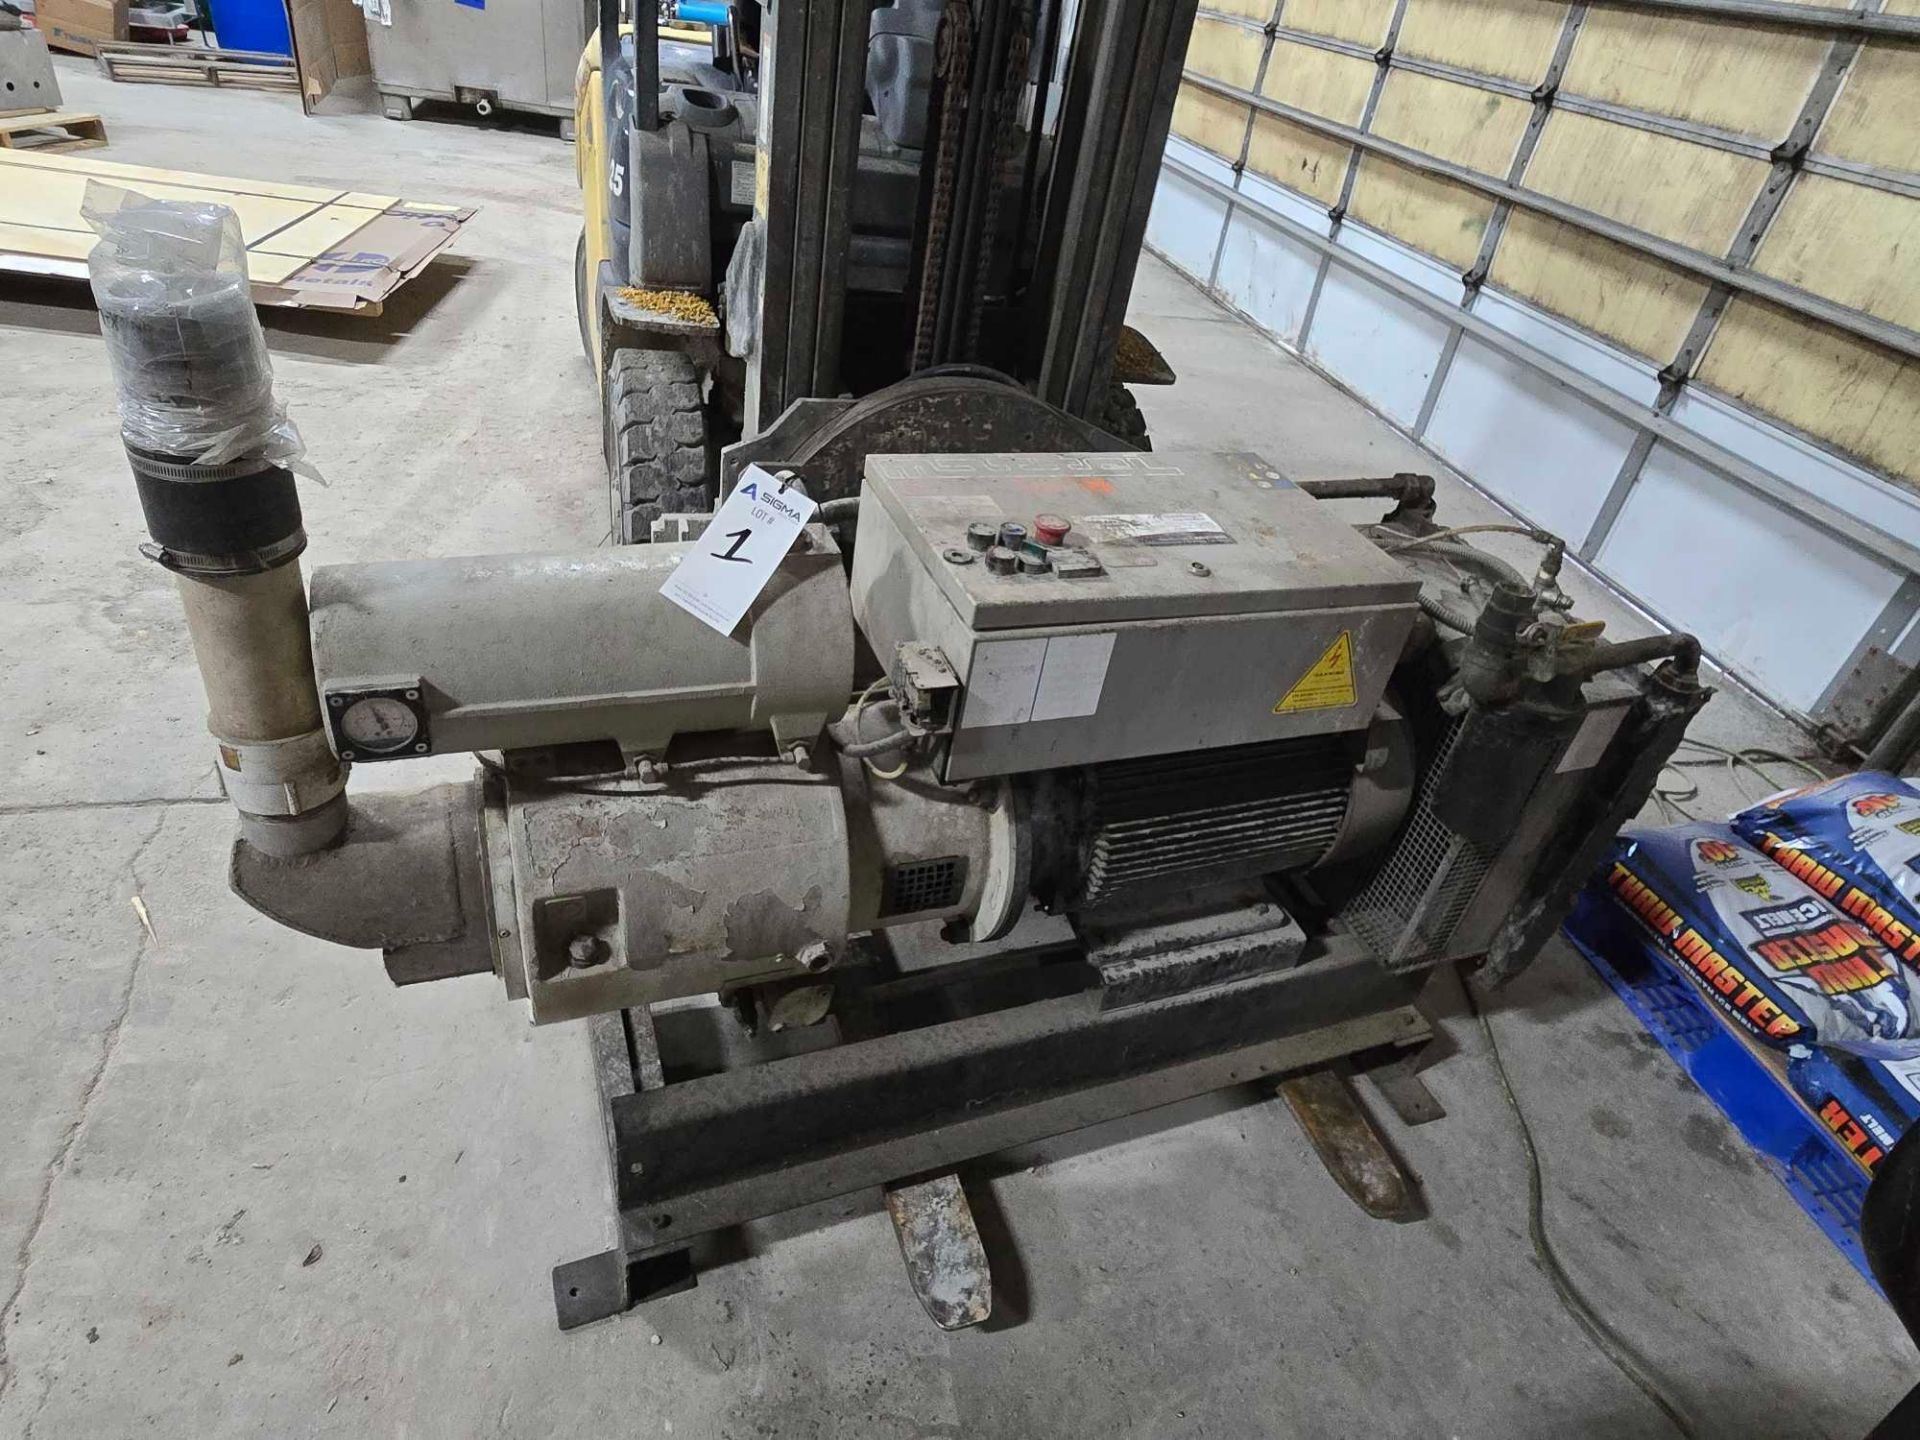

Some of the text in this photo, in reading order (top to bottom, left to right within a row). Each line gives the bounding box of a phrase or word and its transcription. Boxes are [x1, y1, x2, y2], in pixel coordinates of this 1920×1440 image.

[751, 506, 769, 522] LOT
[760, 492, 801, 523] SIGMA
[710, 528, 753, 564] 1
[1761, 831, 1920, 962] THAW MAST
[1606, 861, 1684, 936] THAW
[1673, 927, 1800, 1039] MASTER
[1756, 921, 1884, 971] MASTER
